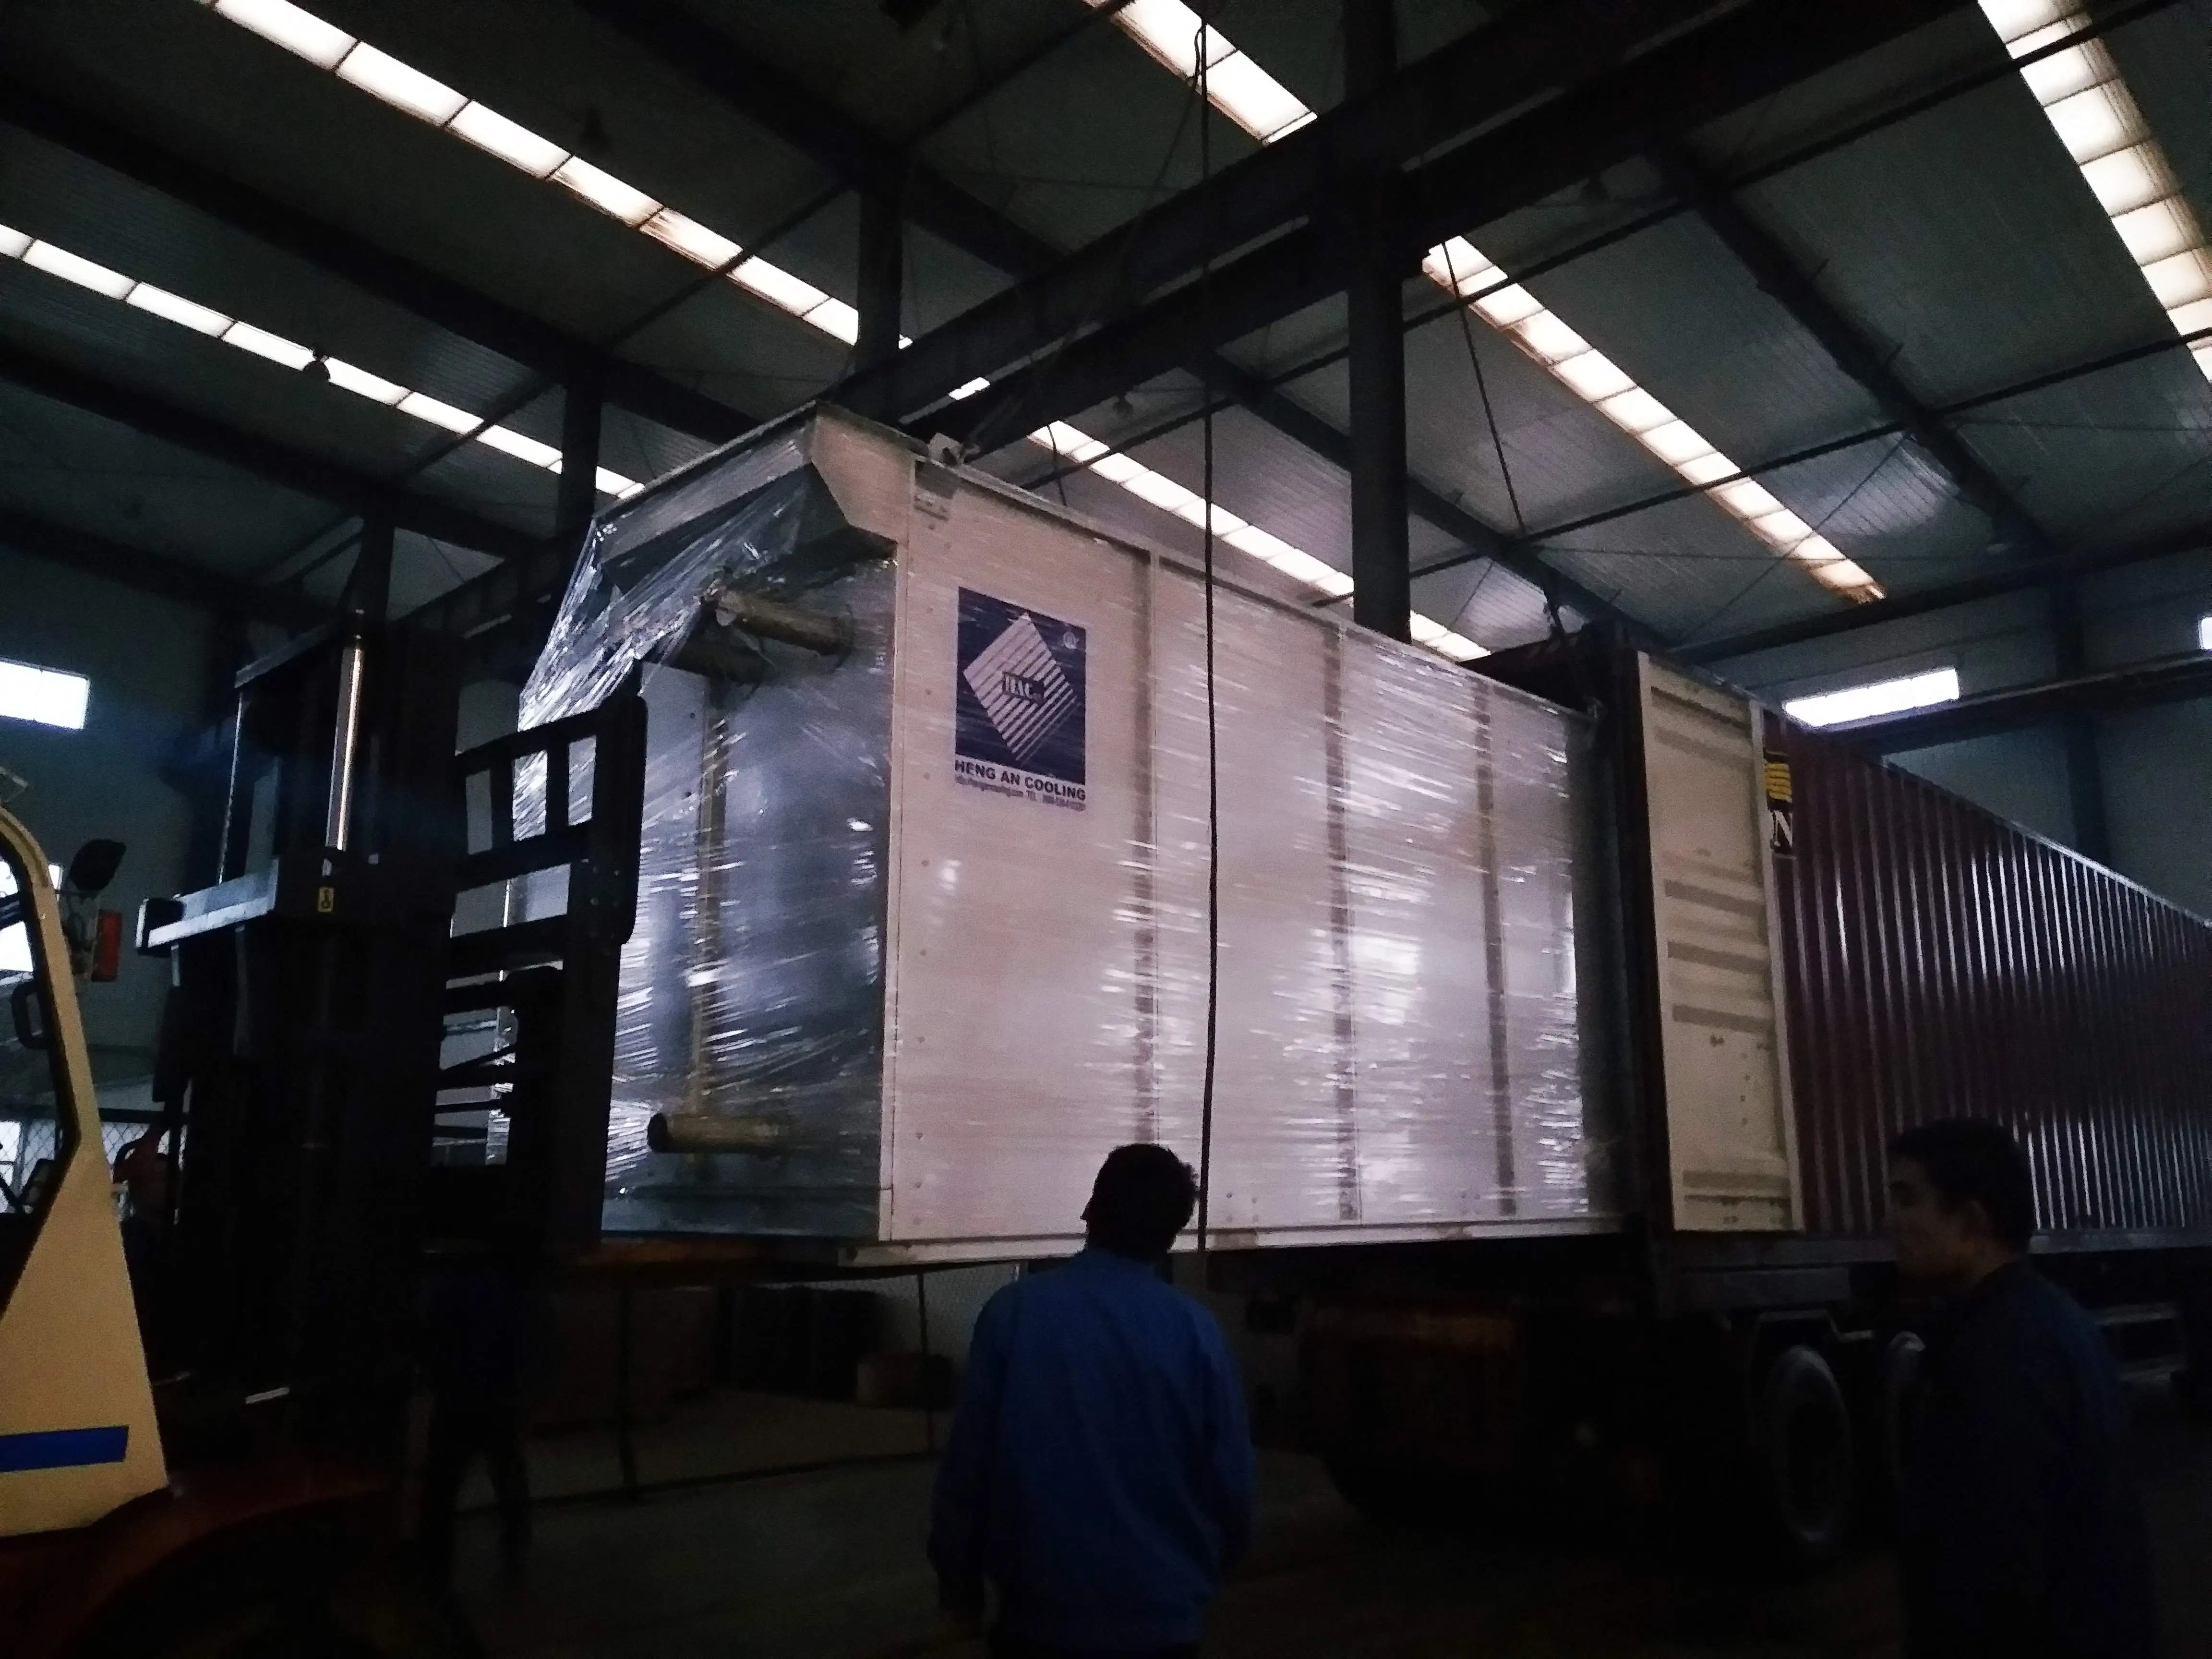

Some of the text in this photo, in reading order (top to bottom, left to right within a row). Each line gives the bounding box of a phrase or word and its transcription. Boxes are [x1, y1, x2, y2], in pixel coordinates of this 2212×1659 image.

[954, 759, 996, 780] HENG
[1000, 771, 1020, 786] AN
[1024, 776, 1086, 801] COOLING
